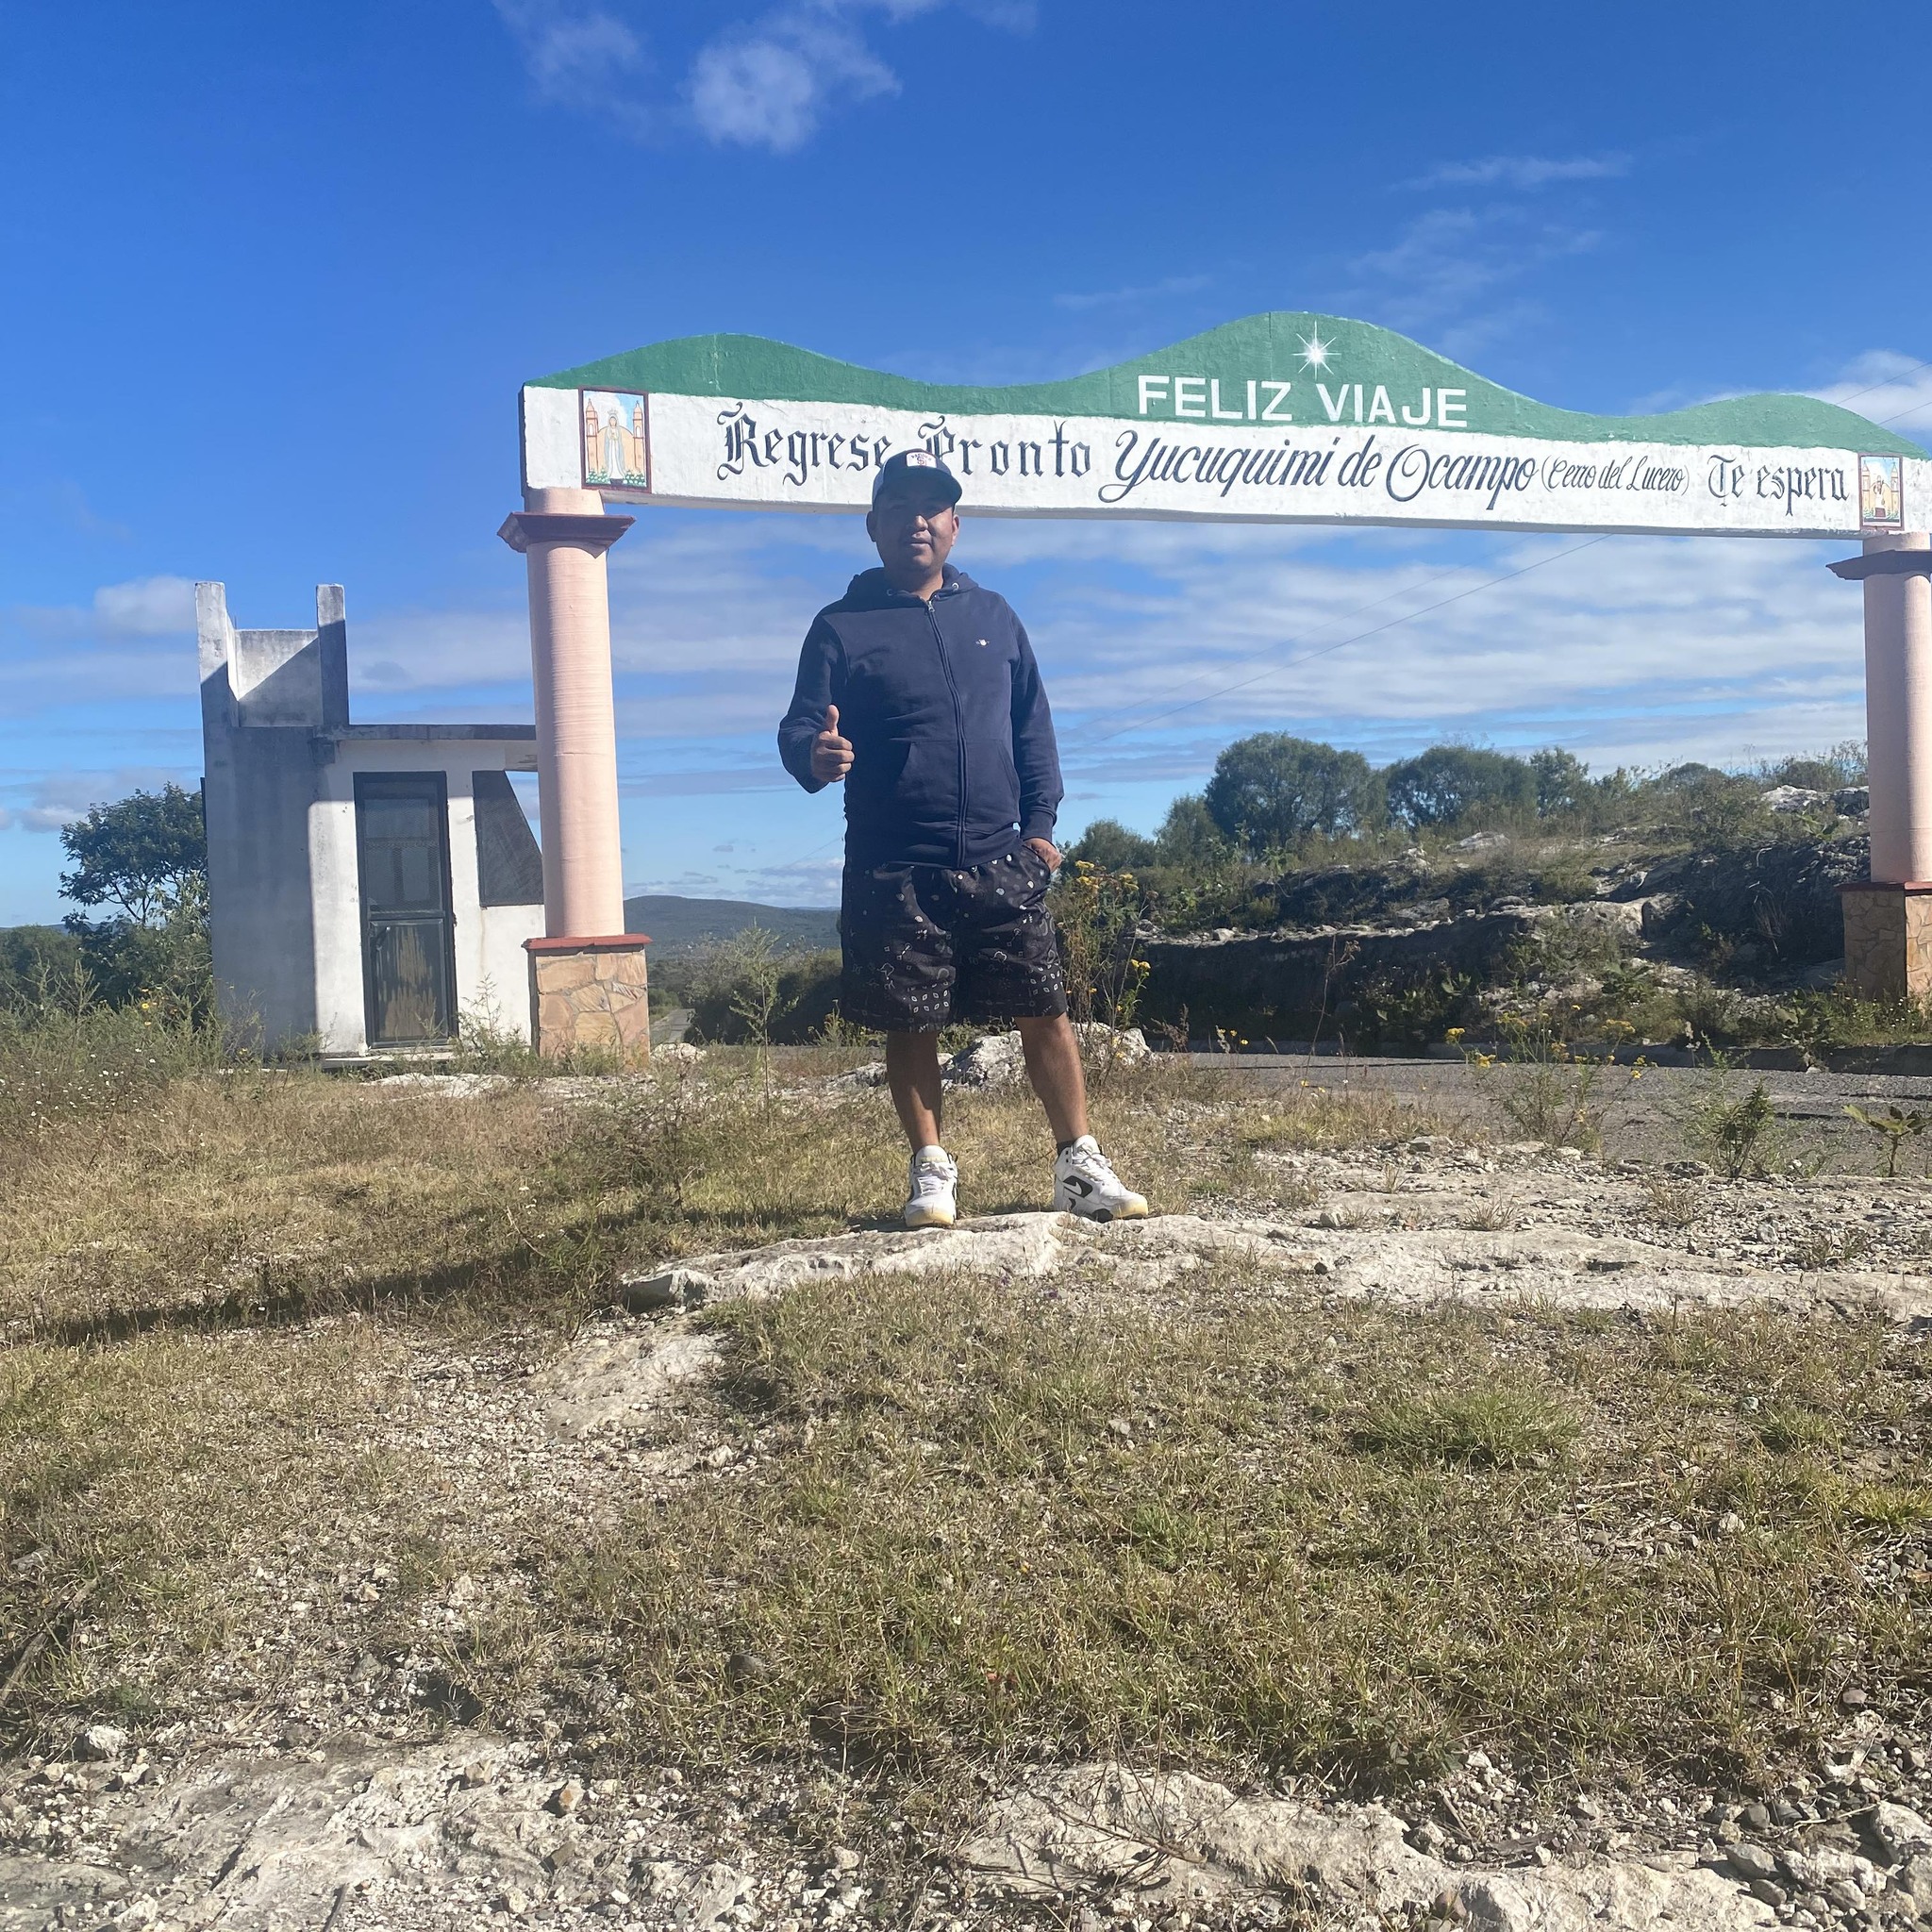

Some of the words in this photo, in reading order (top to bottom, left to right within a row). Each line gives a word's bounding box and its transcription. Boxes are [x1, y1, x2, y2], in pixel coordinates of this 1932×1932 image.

[1138, 375, 1292, 422] FELIZ
[1315, 383, 1468, 427] VIAJE
[717, 401, 892, 486] Regrese
[917, 415, 1091, 477] Pronto
[1337, 434, 1383, 488] de
[1386, 443, 1540, 510] Ocampo
[1598, 456, 1633, 489] del
[1625, 455, 1690, 496] Lucero)
[1707, 454, 1745, 507] Te
[1756, 465, 1850, 517] espera
